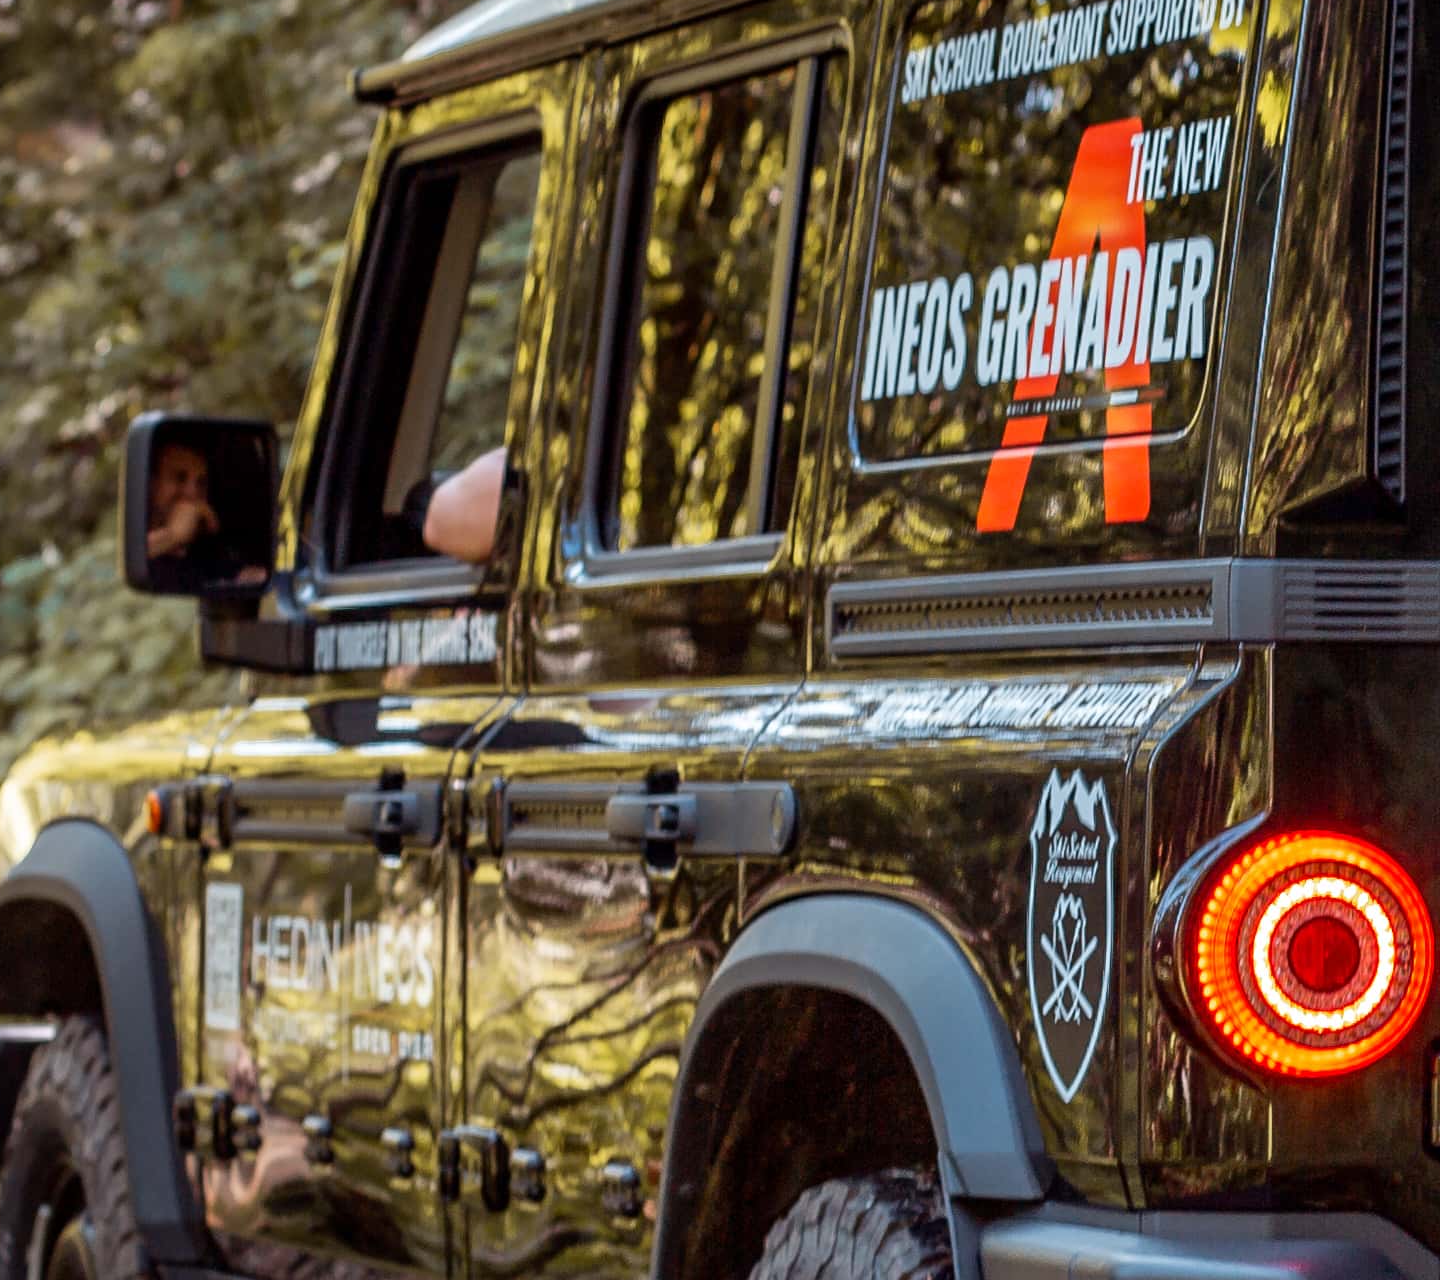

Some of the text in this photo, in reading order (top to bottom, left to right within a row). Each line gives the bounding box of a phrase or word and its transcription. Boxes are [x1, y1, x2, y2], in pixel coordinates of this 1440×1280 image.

[901, 44, 932, 105] SKI
[931, 26, 997, 97] SCHOOL
[997, 0, 1109, 81] ROUGEMONT
[1127, 115, 1231, 205] THE NEW
[861, 235, 1215, 402] INEOS GRENADIER
